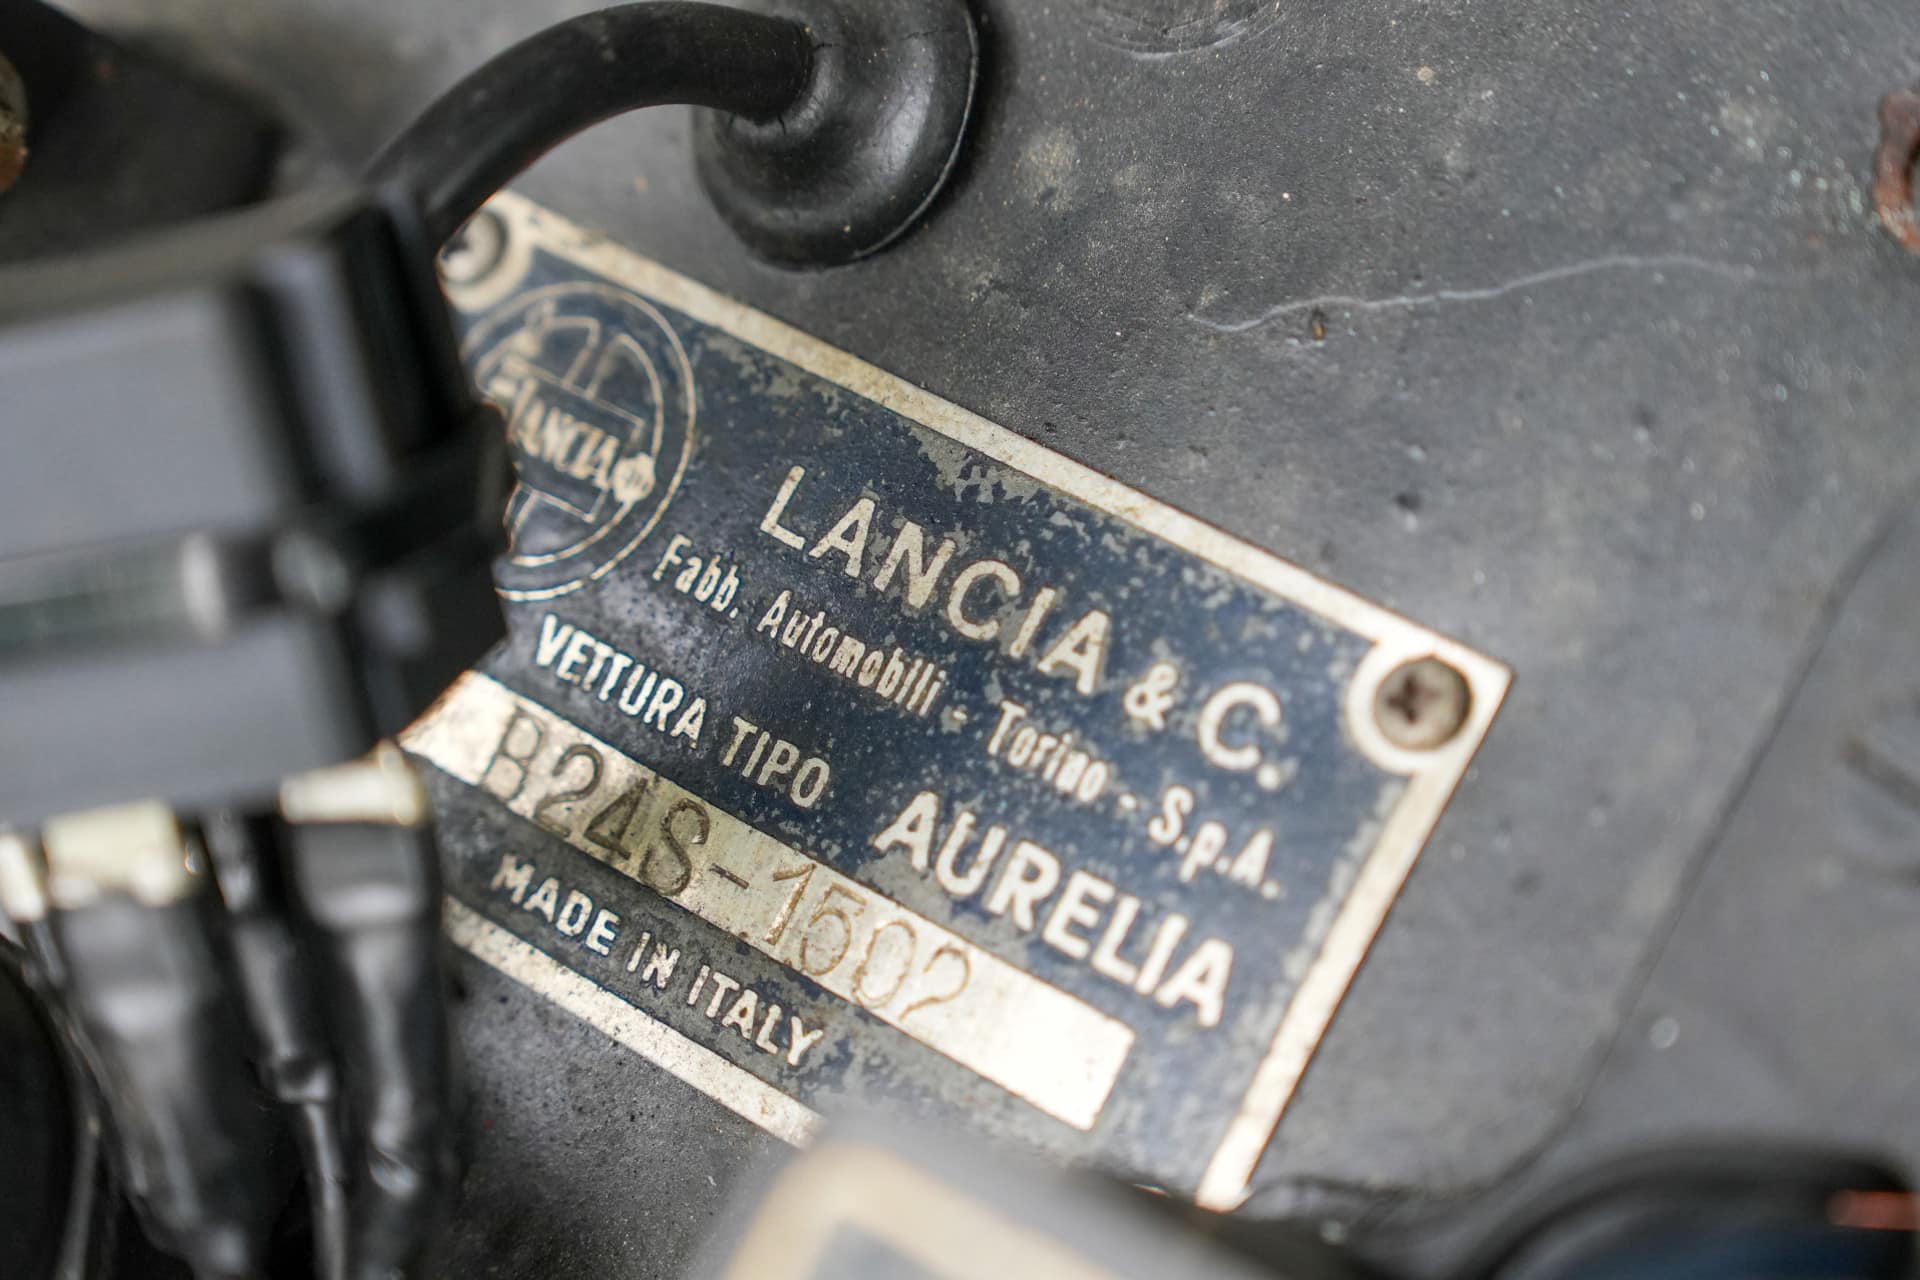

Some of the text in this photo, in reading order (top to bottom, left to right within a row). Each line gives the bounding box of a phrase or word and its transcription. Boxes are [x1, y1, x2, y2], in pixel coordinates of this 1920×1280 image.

[652, 533, 741, 618] Fabb.
[756, 590, 947, 718] Automobili
[986, 699, 1108, 802] Torino
[1148, 785, 1281, 899] S.p.A.
[760, 465, 1283, 791] LANCIA & C.
[481, 704, 972, 1022] B24S-1502
[490, 853, 824, 1066] MADE IN ITALY
[535, 613, 1235, 1028] VETTURA TIPO AURELIA
